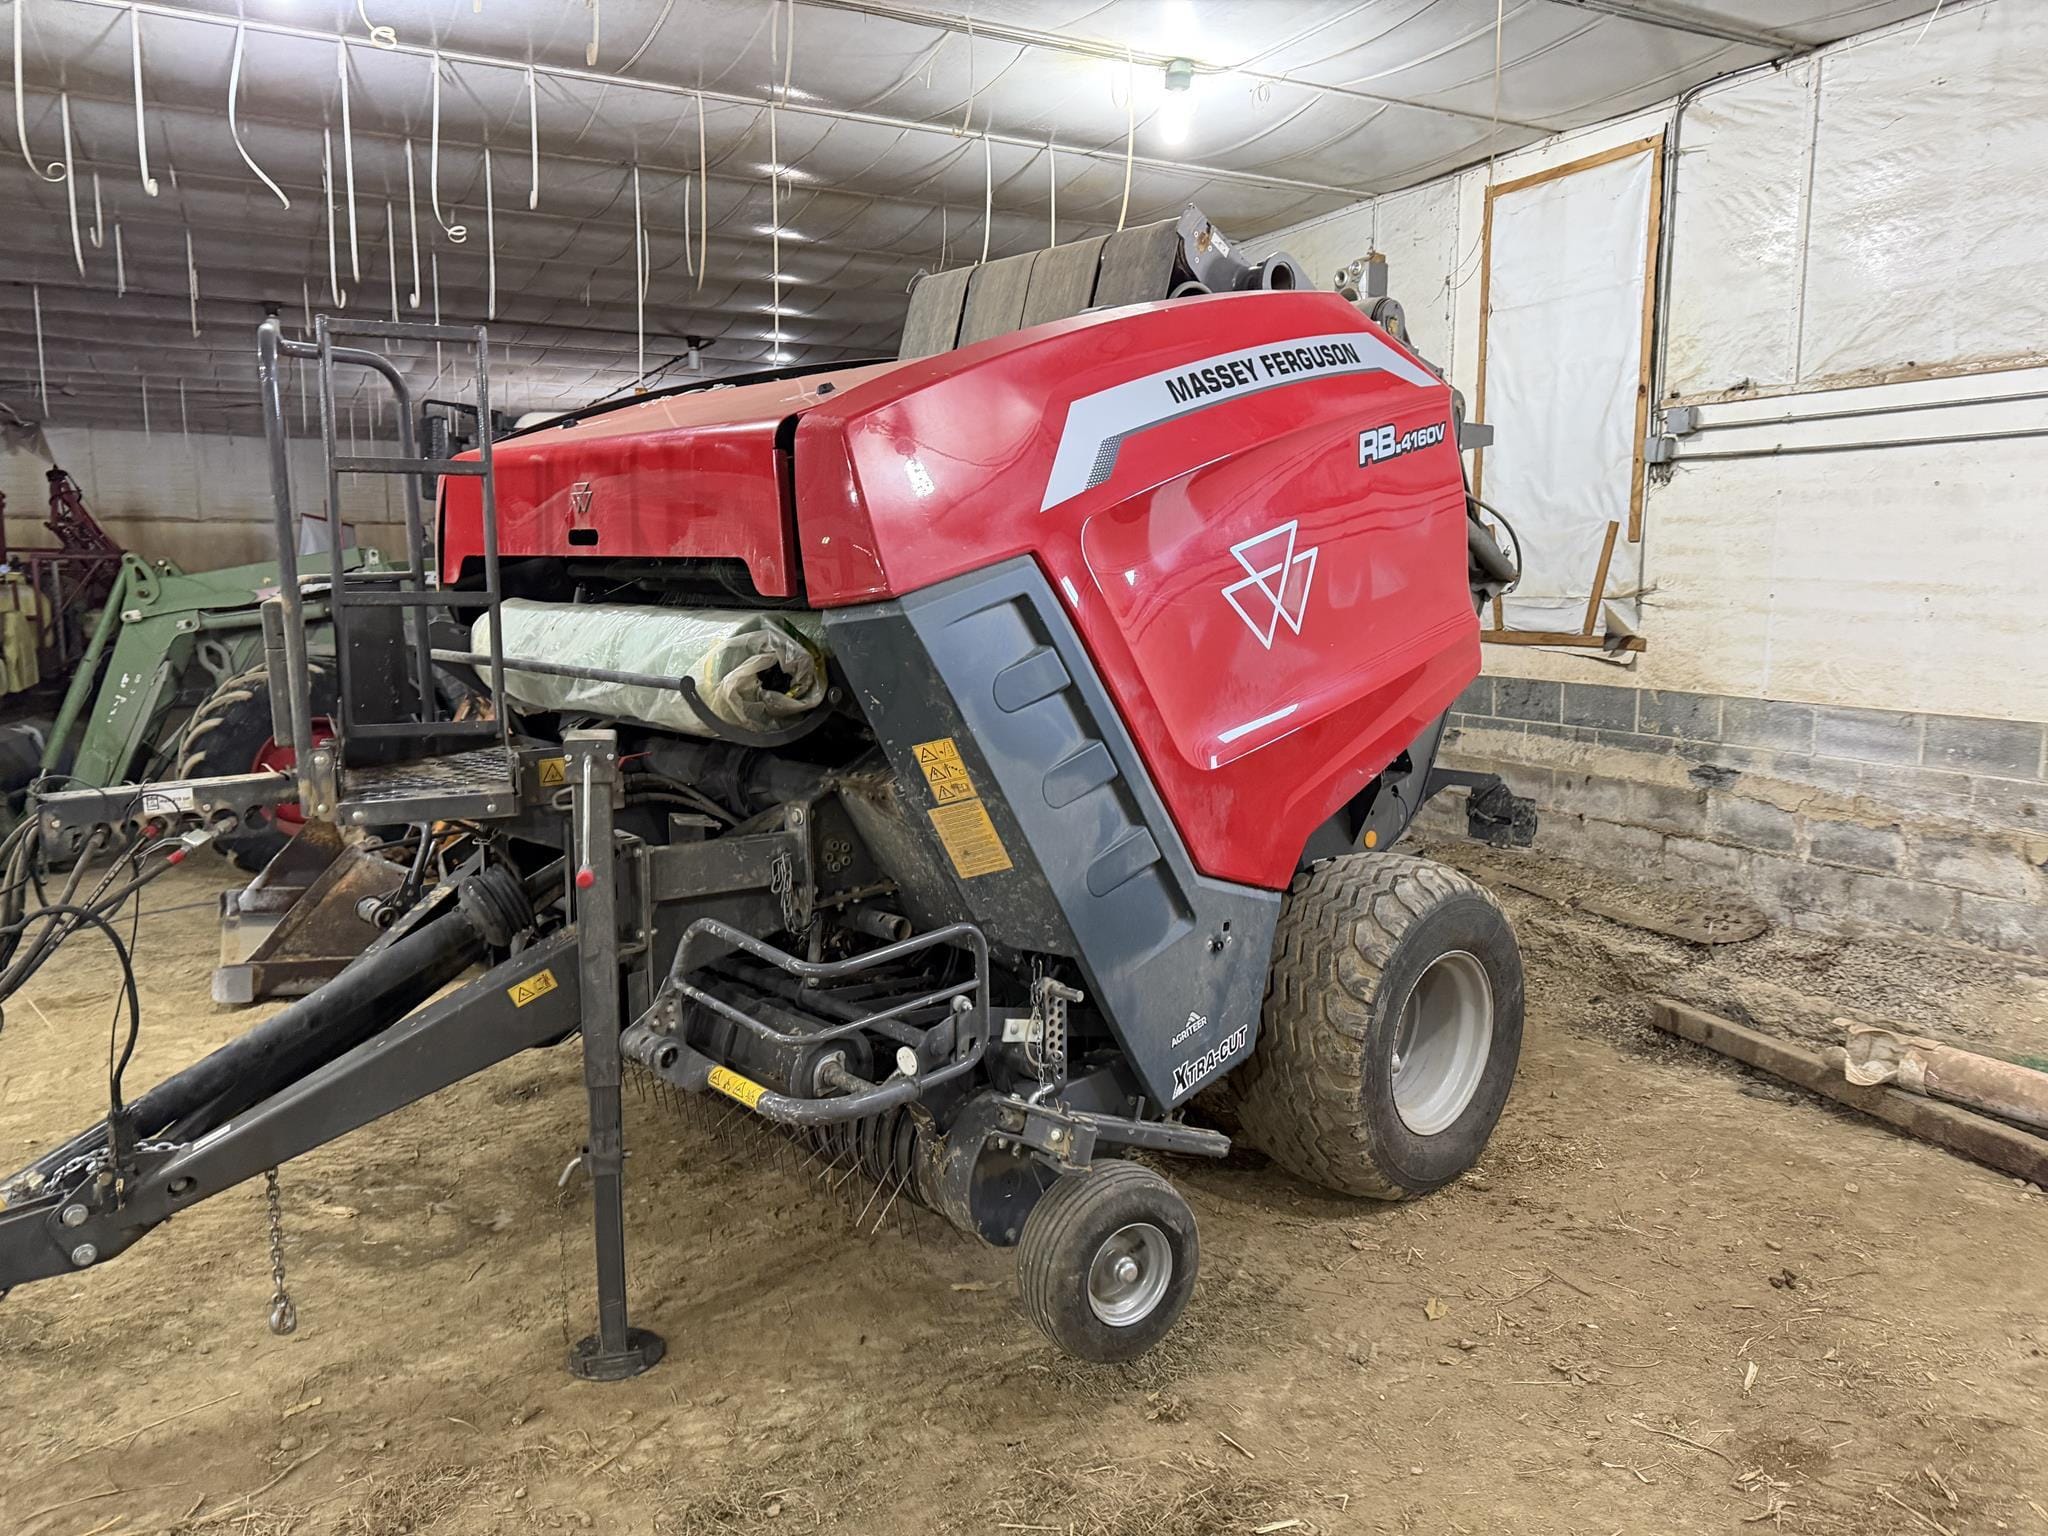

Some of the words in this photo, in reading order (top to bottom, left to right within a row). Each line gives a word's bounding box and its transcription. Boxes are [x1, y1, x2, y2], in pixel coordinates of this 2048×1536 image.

[1165, 358, 1258, 404] MASSEY
[1259, 342, 1361, 378] FERGUSON
[1171, 1016, 1208, 1048] AGRITEER
[1172, 1024, 1248, 1100] XTRA-CUT
